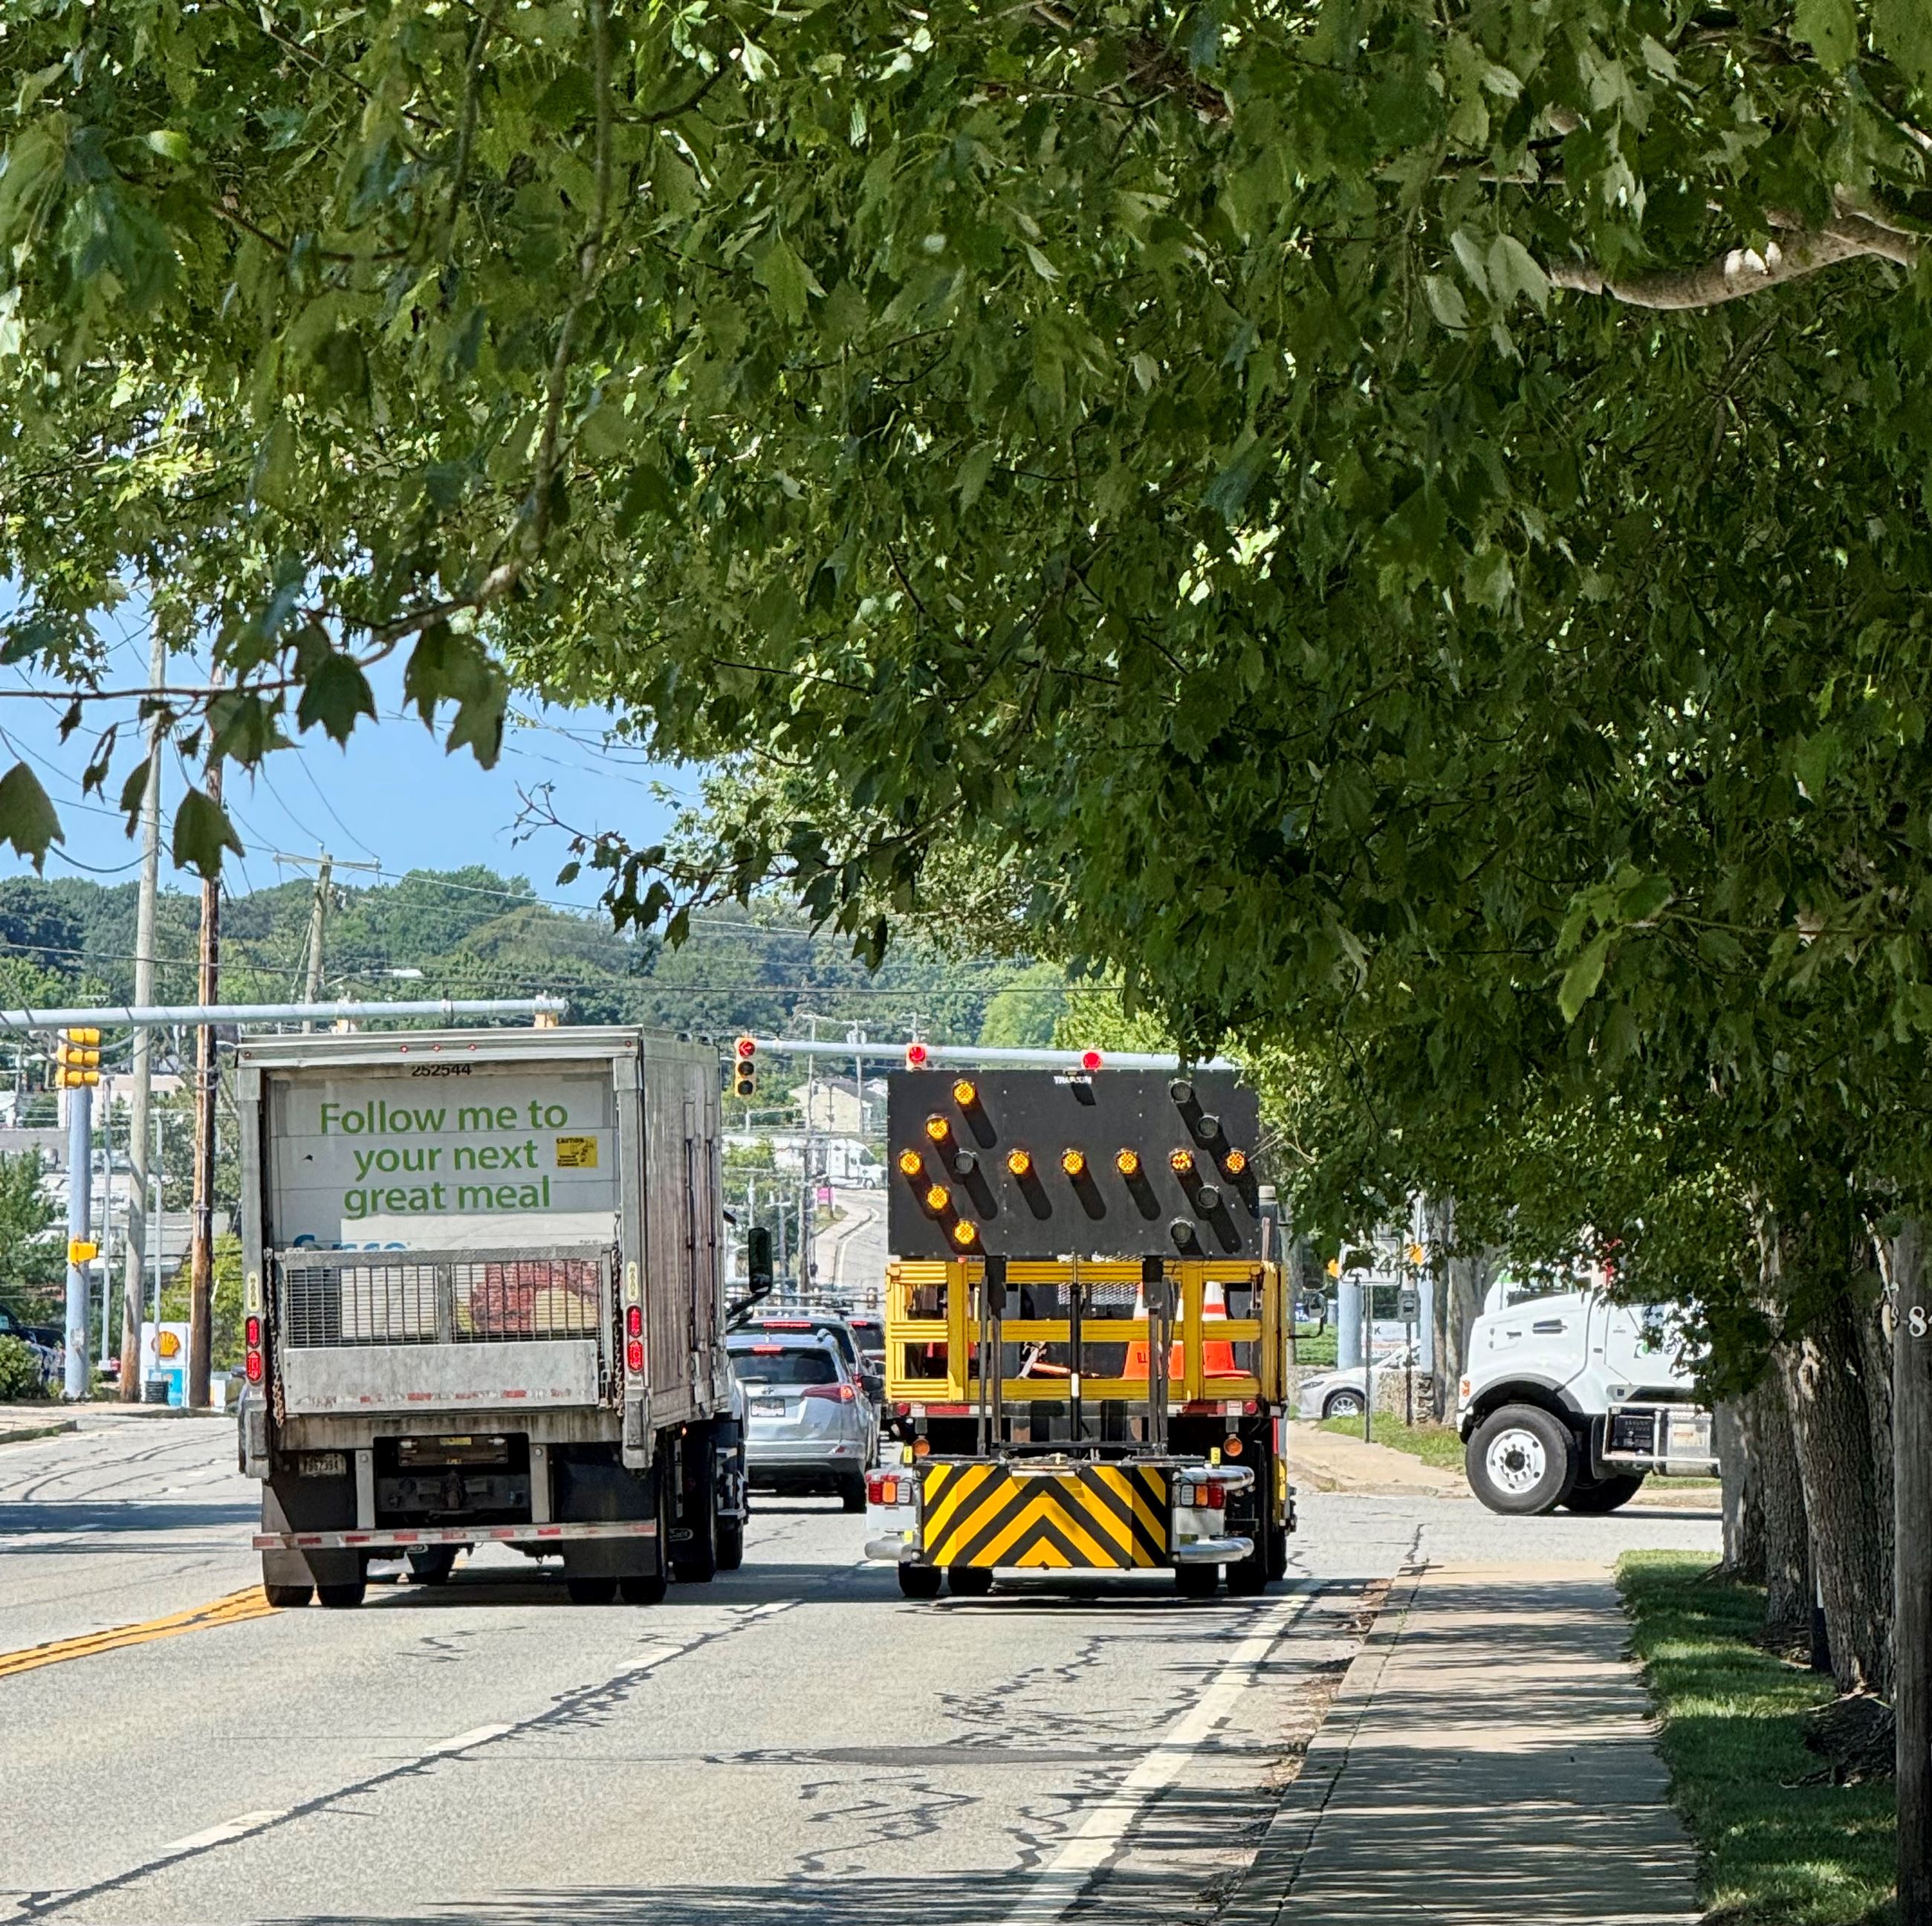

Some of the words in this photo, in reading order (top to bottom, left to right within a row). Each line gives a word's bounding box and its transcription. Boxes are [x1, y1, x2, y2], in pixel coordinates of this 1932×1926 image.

[412, 1063, 472, 1077] 252544
[320, 1102, 446, 1133] Follow
[458, 1107, 518, 1130] me
[528, 1100, 568, 1128] to
[354, 1149, 442, 1181] your
[454, 1141, 539, 1170] next
[343, 1181, 446, 1219] great
[458, 1176, 551, 1210] meal
